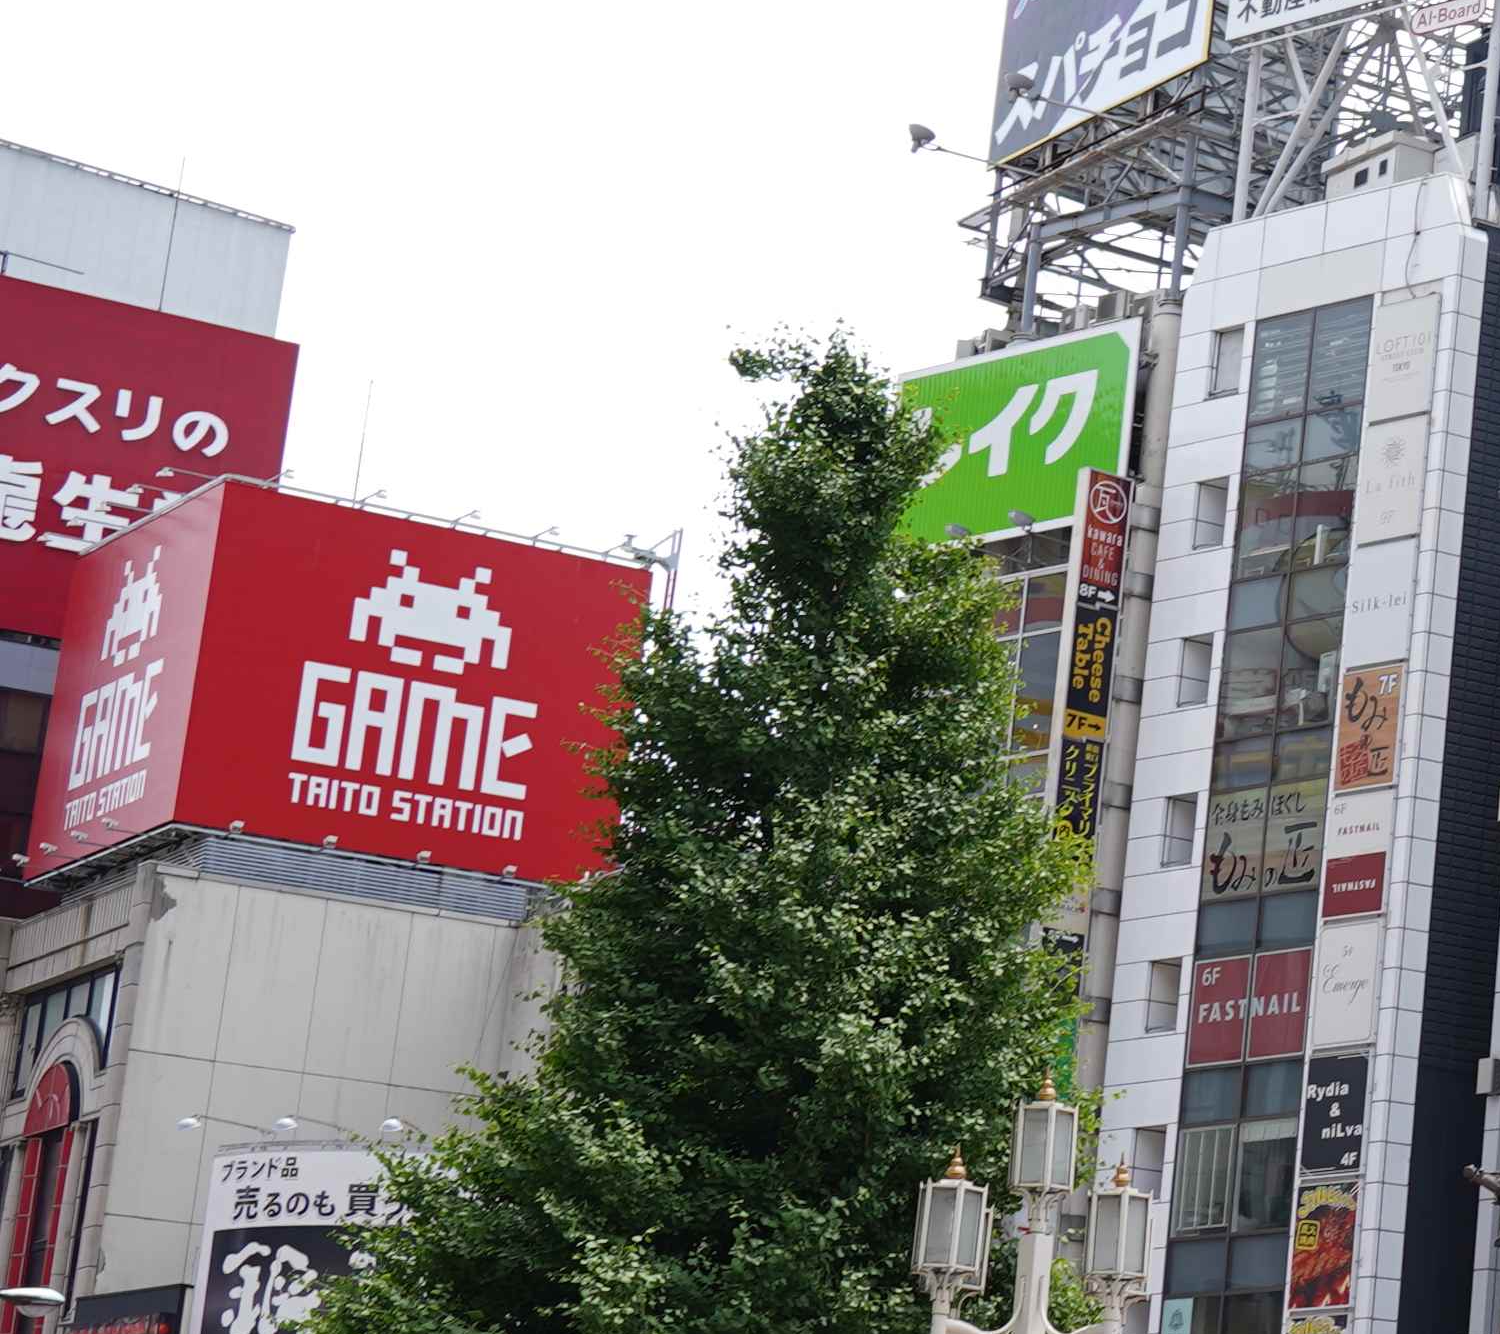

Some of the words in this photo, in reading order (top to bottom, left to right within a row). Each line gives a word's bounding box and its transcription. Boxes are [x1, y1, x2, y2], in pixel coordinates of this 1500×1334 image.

[1086, 523, 1124, 548] kawara
[1081, 564, 1119, 587] DINING
[1078, 582, 1098, 599] 8F
[1071, 622, 1095, 690] Table
[1087, 616, 1112, 704] Cheese
[1377, 674, 1400, 697] 7F
[68, 659, 165, 791] GAME
[290, 660, 539, 800] GAME
[1065, 714, 1089, 732] 7F
[62, 789, 95, 833] TAITO
[96, 768, 145, 818] STATION
[288, 772, 381, 818] TAITO
[391, 791, 525, 842] STATION
[1201, 967, 1222, 987] 6F
[1197, 991, 1301, 1025] FASTNAIL
[1306, 1080, 1350, 1103] Rydia
[1329, 1101, 1342, 1118] &
[221, 1156, 300, 1184] ブランド品
[1339, 1150, 1358, 1167] 4F
